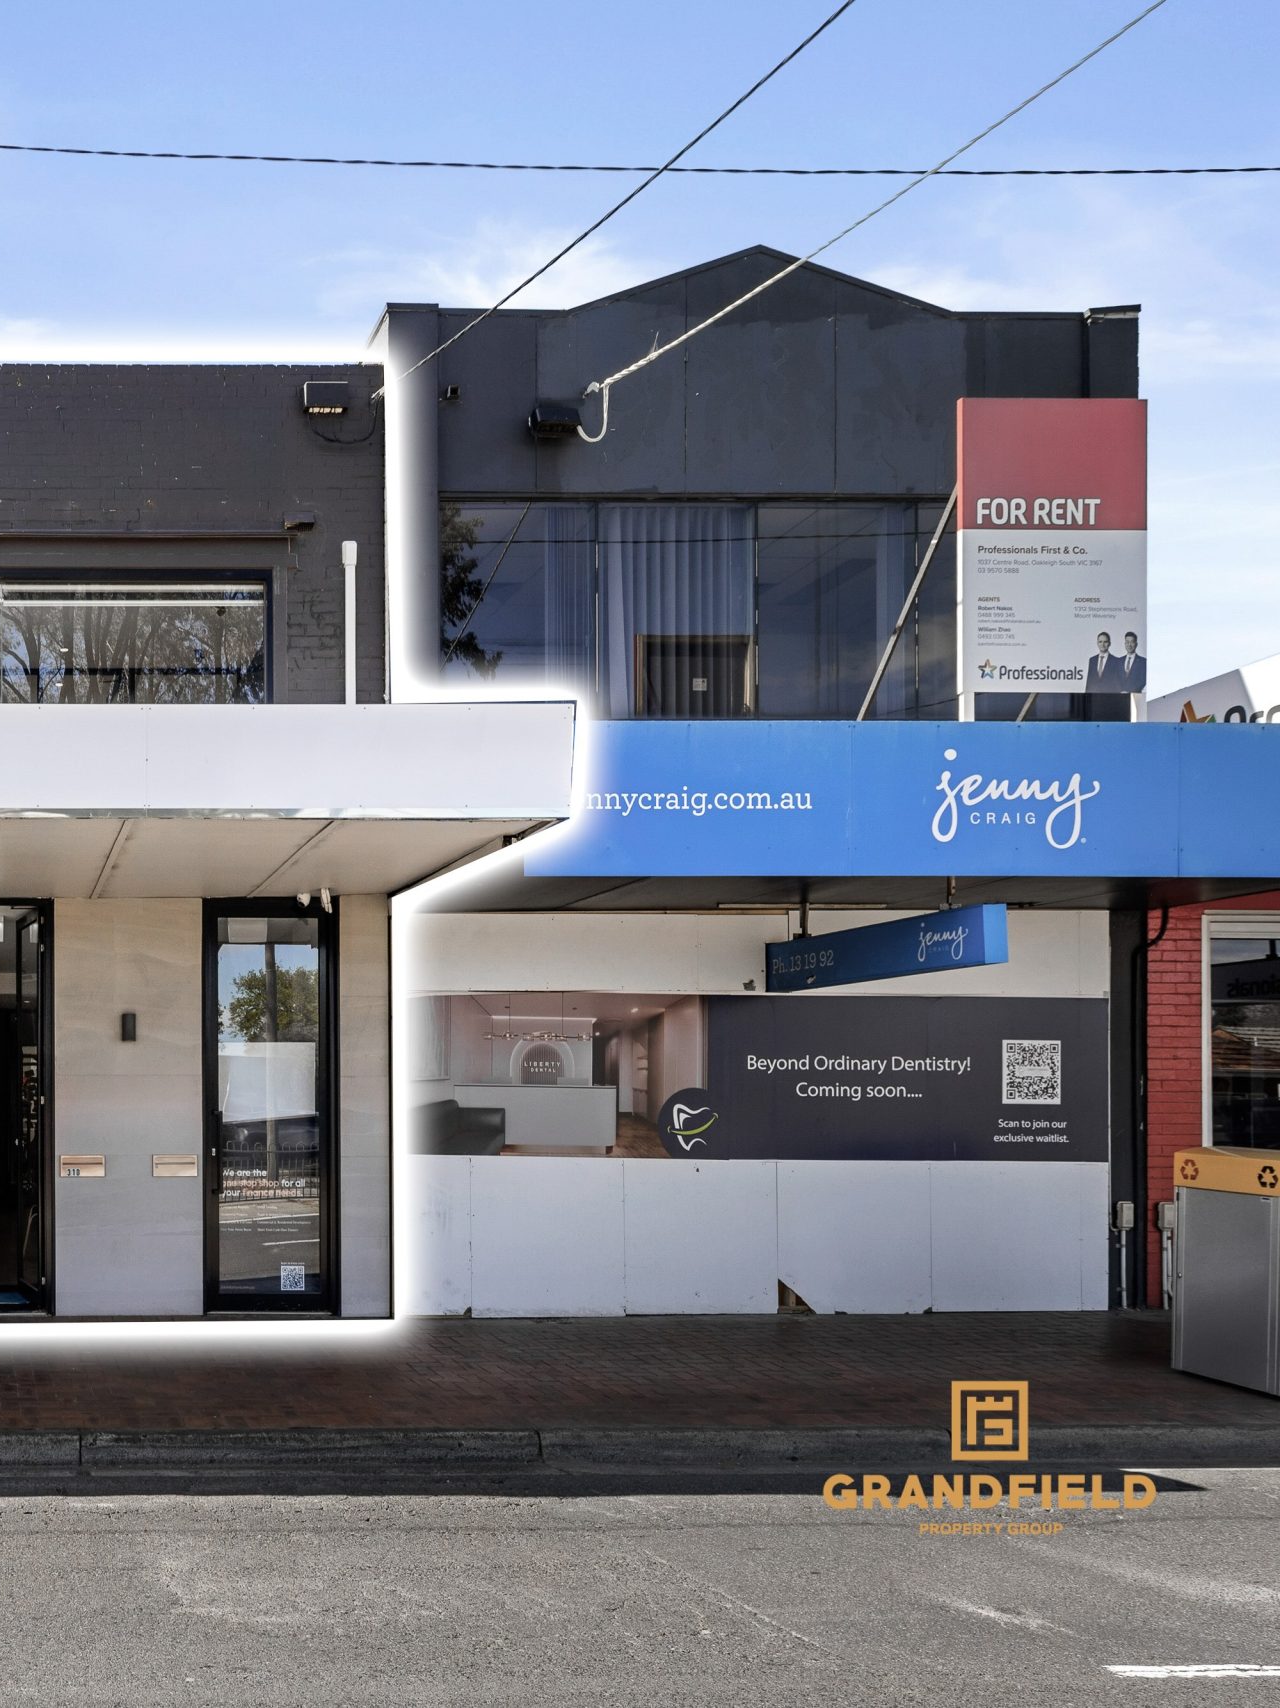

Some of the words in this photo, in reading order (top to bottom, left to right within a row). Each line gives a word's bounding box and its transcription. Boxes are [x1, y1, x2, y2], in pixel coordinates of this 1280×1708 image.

[976, 497, 1027, 525] FOR
[1033, 498, 1101, 525] RENT
[977, 545, 1039, 554] Professionals
[1040, 545, 1061, 554] First
[1062, 546, 1070, 554] &
[1072, 546, 1088, 555] Co.
[1031, 559, 1058, 567] Oakleigh
[999, 665, 1084, 681] Professionals
[931, 748, 1101, 849] jenny
[970, 811, 1037, 825] CRAIG
[918, 922, 969, 962] jenny
[772, 958, 788, 974] Ph.
[789, 955, 802, 972] 13
[804, 953, 817, 969] 19
[819, 950, 834, 967] 92
[747, 1055, 810, 1074] Beyond
[814, 1055, 887, 1075] Ordinary
[891, 1056, 971, 1075] Dentistry!
[796, 1082, 861, 1101] Coming
[998, 1119, 1020, 1128] Scan
[1021, 1120, 1031, 1128] to
[1032, 1120, 1050, 1130] join
[993, 1133, 1034, 1143] exclusive
[1036, 1134, 1070, 1143] waitlist.
[253, 1168, 267, 1177] the
[259, 1179, 279, 1189] shop
[281, 1179, 294, 1187] for
[295, 1179, 306, 1187] all
